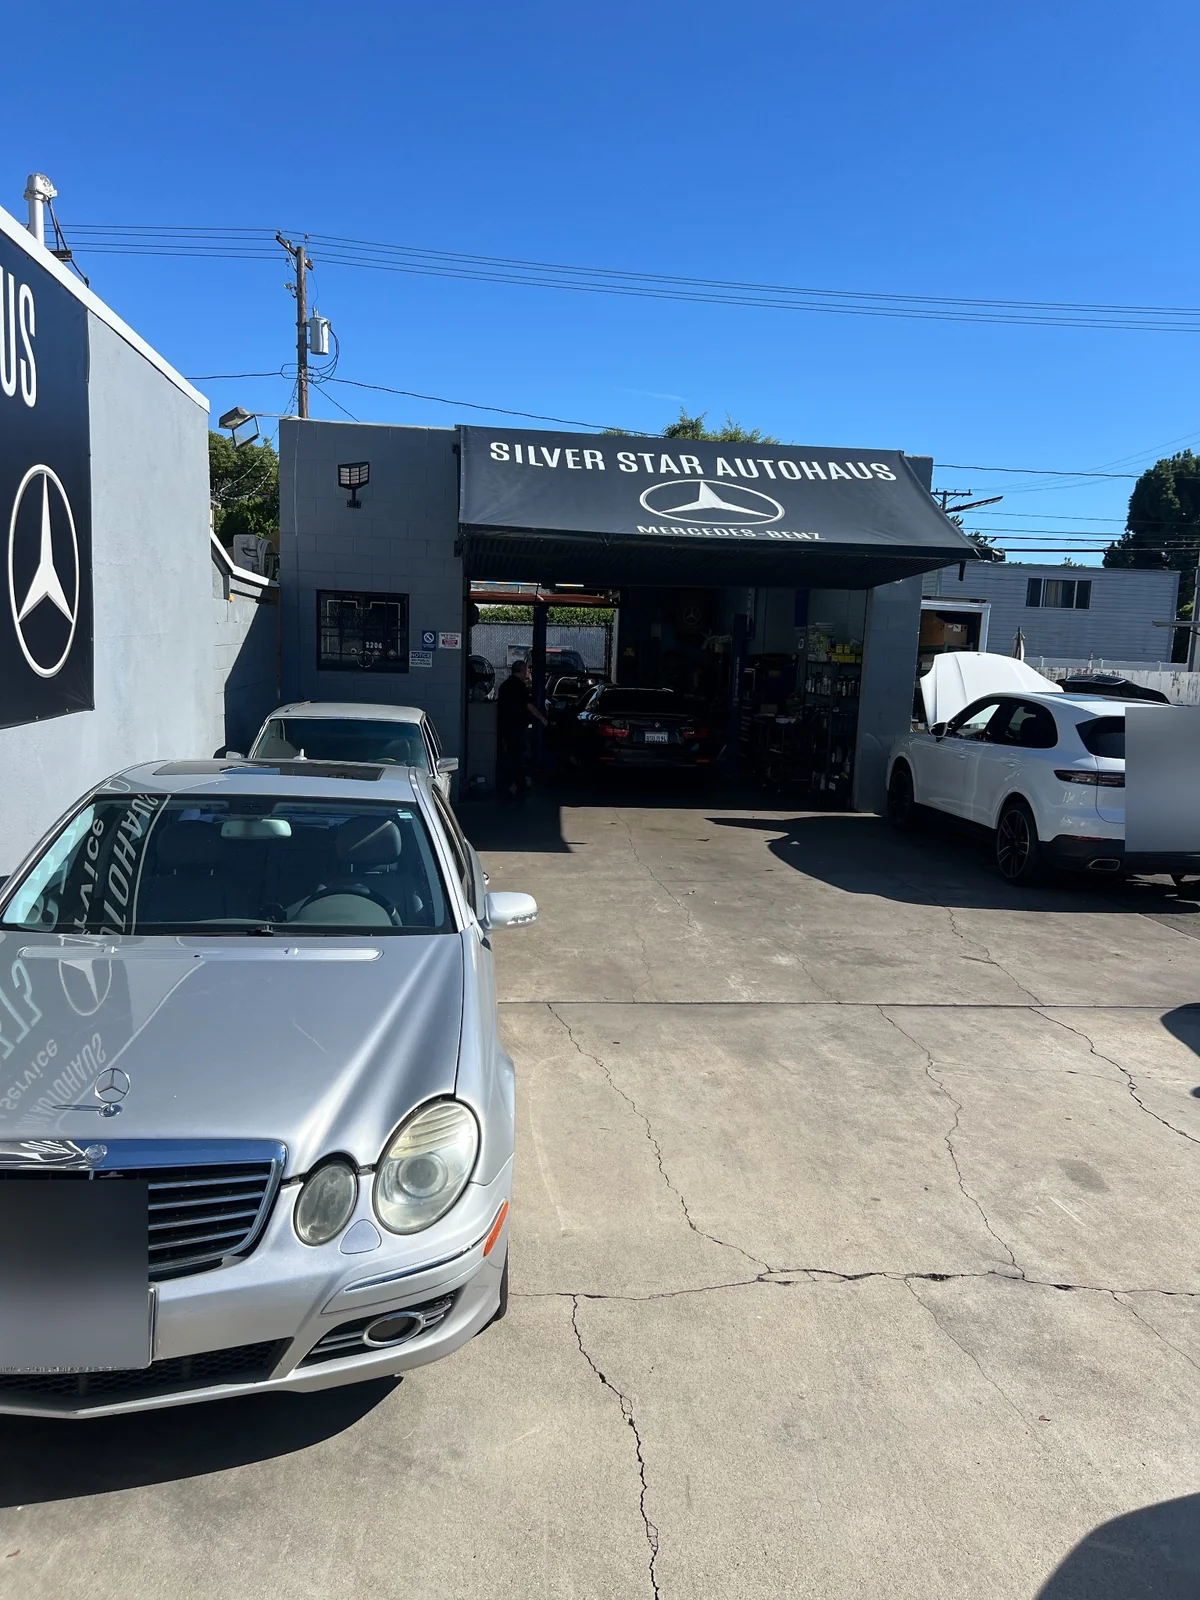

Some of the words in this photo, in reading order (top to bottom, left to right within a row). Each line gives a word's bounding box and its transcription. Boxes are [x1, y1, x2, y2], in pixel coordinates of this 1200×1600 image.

[490, 442, 605, 471] SILVER
[617, 452, 705, 475] STAR
[717, 457, 897, 481] AUTOHAUS
[637, 525, 826, 540] MERCEDES-BENZ
